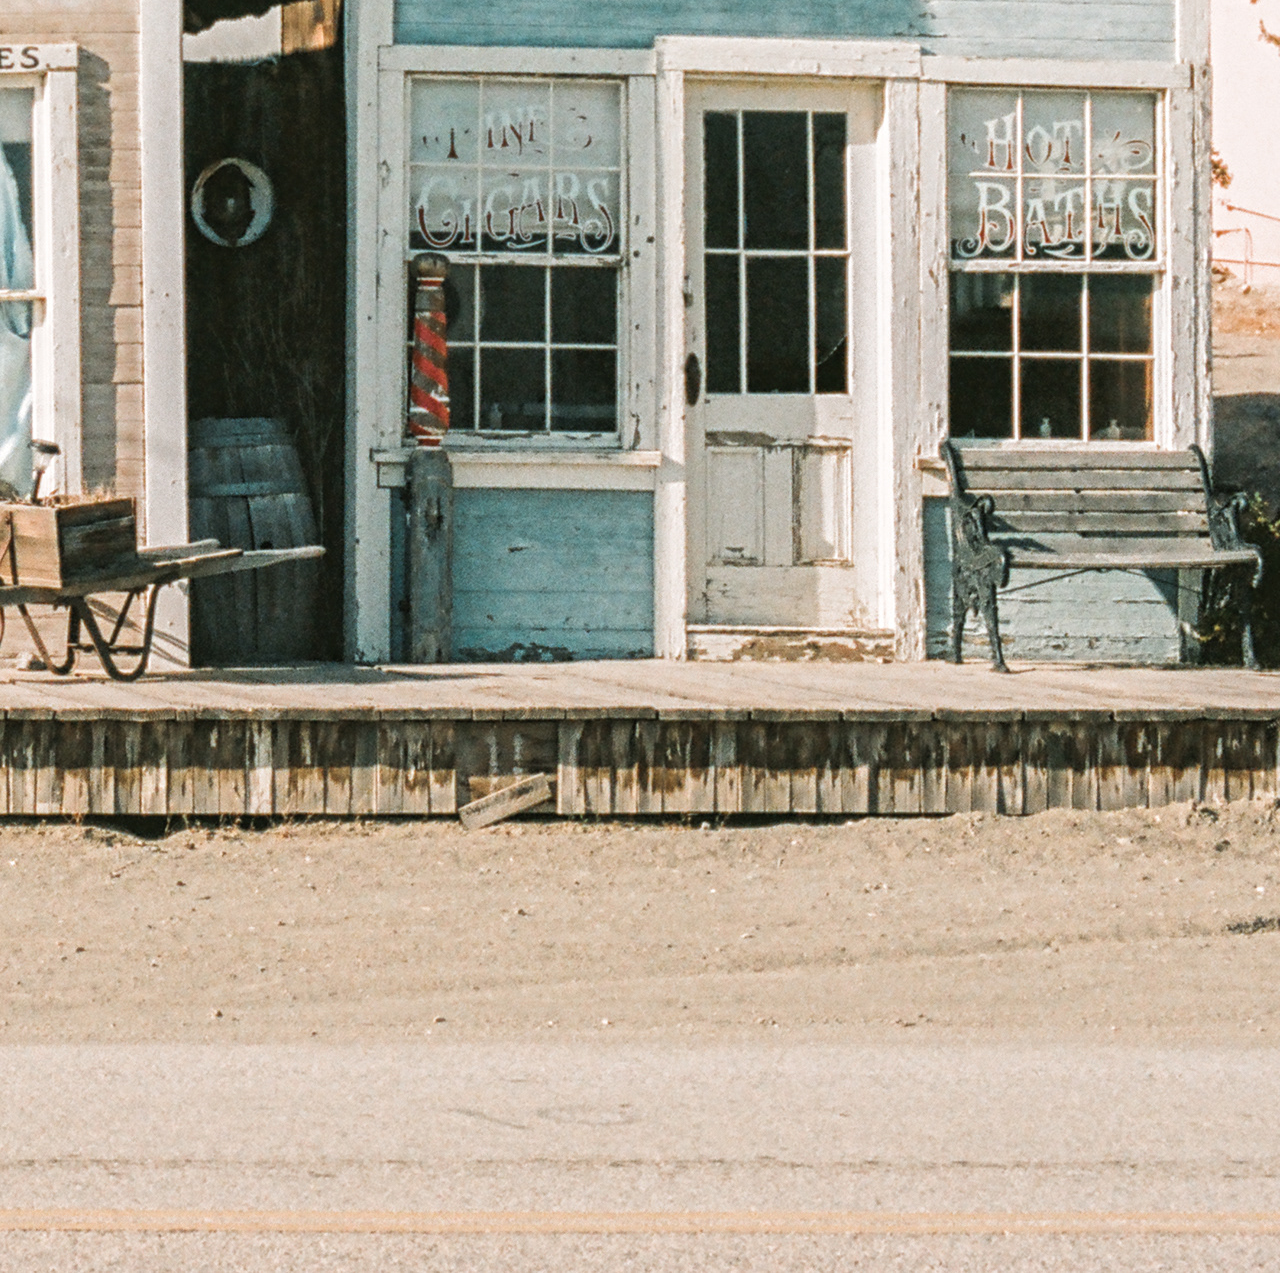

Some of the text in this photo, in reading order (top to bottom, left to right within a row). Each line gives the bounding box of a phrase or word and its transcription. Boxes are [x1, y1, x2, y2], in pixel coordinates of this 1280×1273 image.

[984, 111, 1083, 171] HOT
[415, 173, 614, 253] CIGARS
[956, 181, 1155, 260] BATHS
